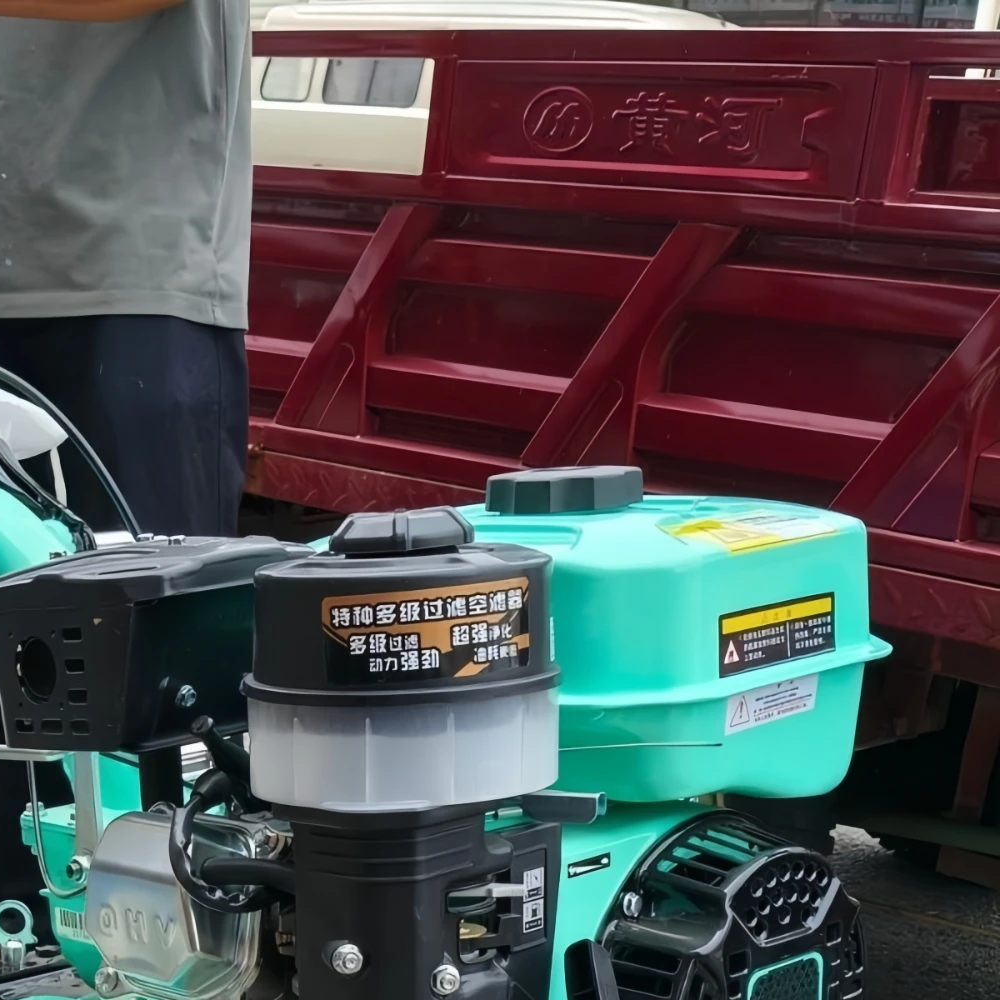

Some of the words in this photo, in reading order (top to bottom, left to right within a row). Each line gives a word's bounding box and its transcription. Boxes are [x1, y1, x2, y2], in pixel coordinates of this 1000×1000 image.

[612, 92, 783, 160] 黄河
[332, 589, 522, 626] 特种多级过滤空滤器
[349, 633, 419, 655] 多级过滤
[369, 649, 440, 673] 动力强劲
[99, 905, 178, 949] OHV
